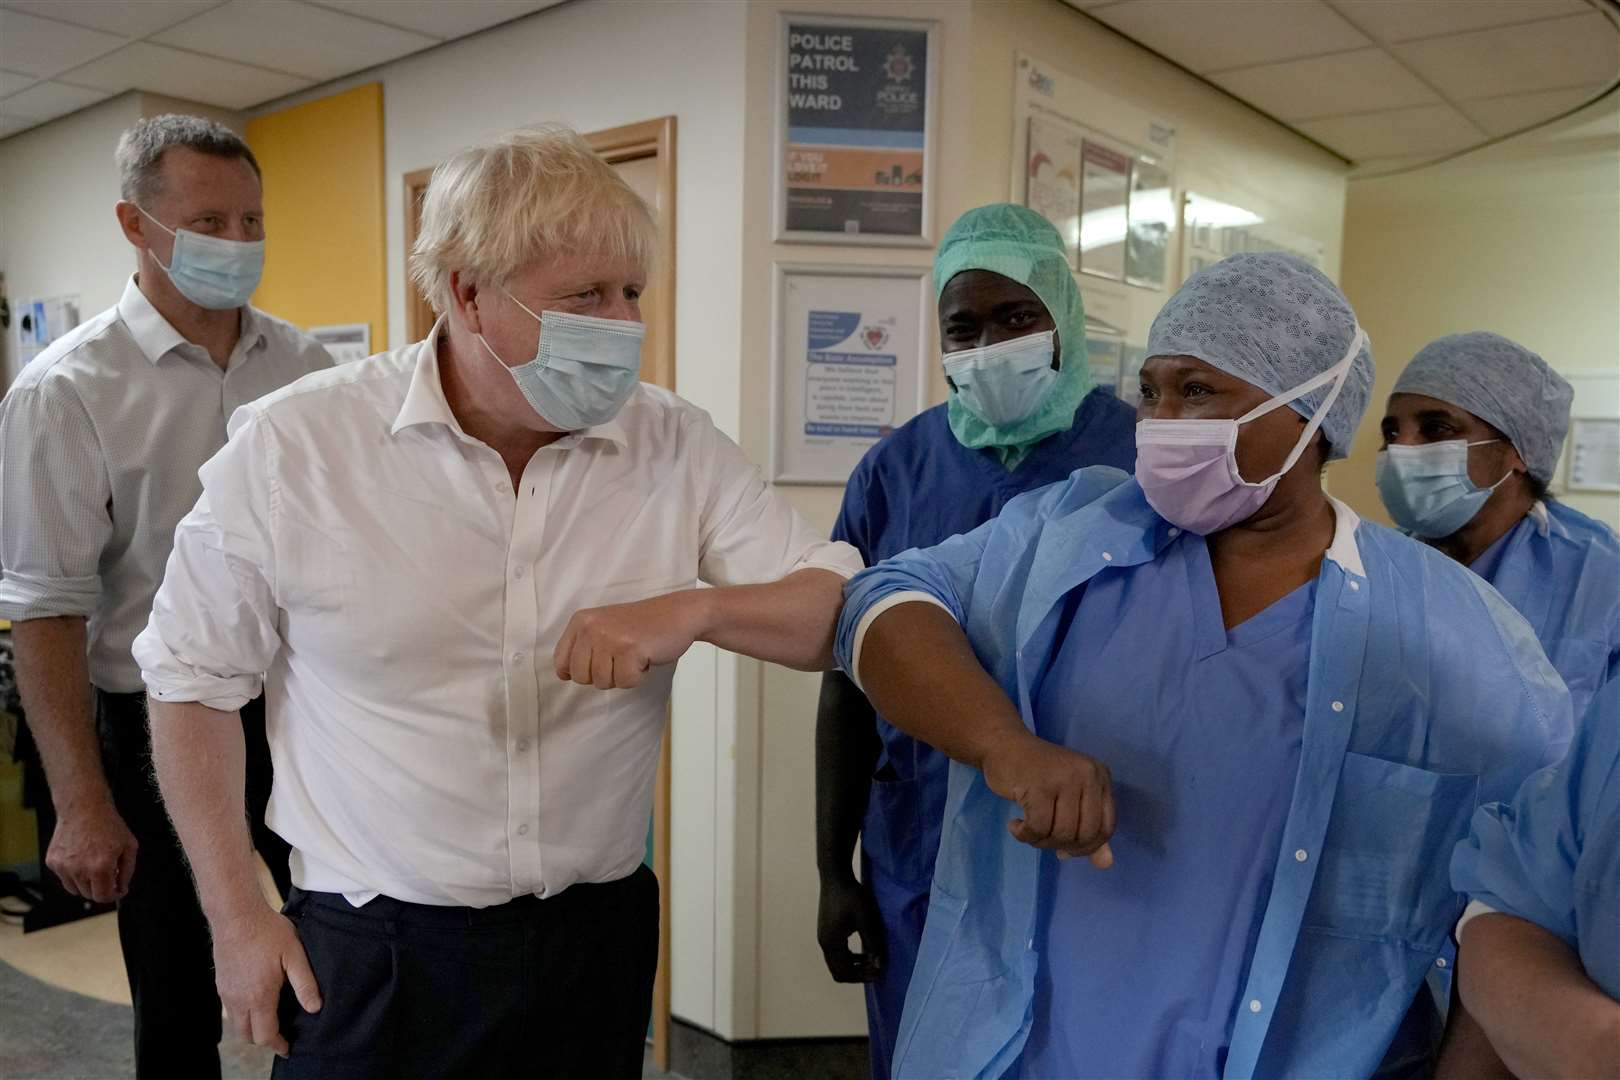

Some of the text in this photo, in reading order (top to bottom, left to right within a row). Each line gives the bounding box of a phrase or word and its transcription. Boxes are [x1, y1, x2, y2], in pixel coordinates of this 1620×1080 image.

[790, 34, 852, 51] POLICE
[790, 54, 859, 71] PATROL
[791, 74, 829, 90] THIS
[790, 94, 842, 110] WARD
